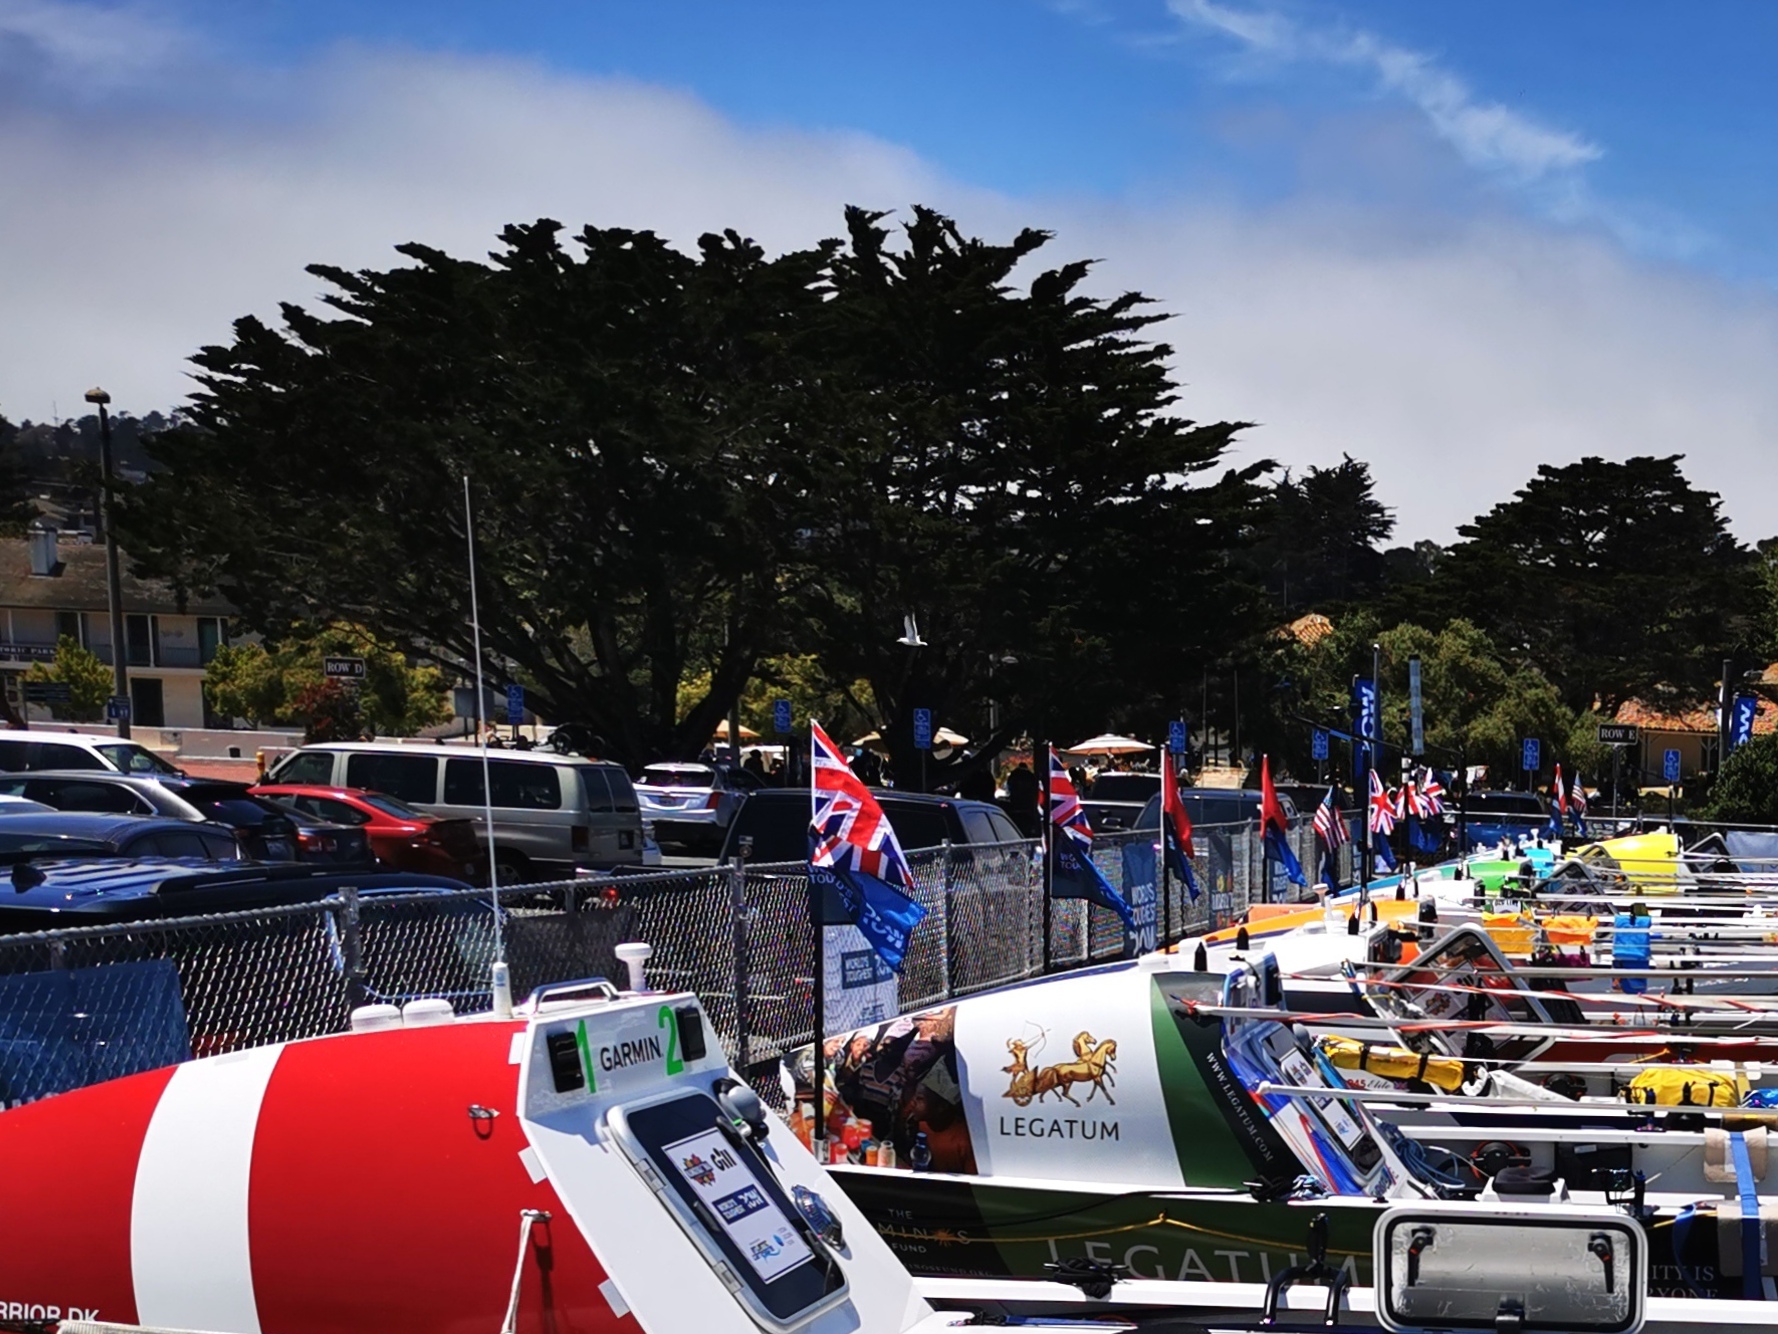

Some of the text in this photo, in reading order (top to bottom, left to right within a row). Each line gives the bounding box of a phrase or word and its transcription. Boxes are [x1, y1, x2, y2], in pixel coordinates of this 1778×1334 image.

[327, 662, 363, 674] ROW D
[1601, 727, 1636, 740] ROW E
[576, 1004, 684, 1094] 1 GARMIN 2
[1205, 1051, 1275, 1164] WWW.LEGATUM.COM
[999, 1116, 1121, 1142] LEGATUM
[887, 1208, 913, 1220] THE
[890, 1242, 928, 1255] FUND
[1694, 1265, 1715, 1281] IS
